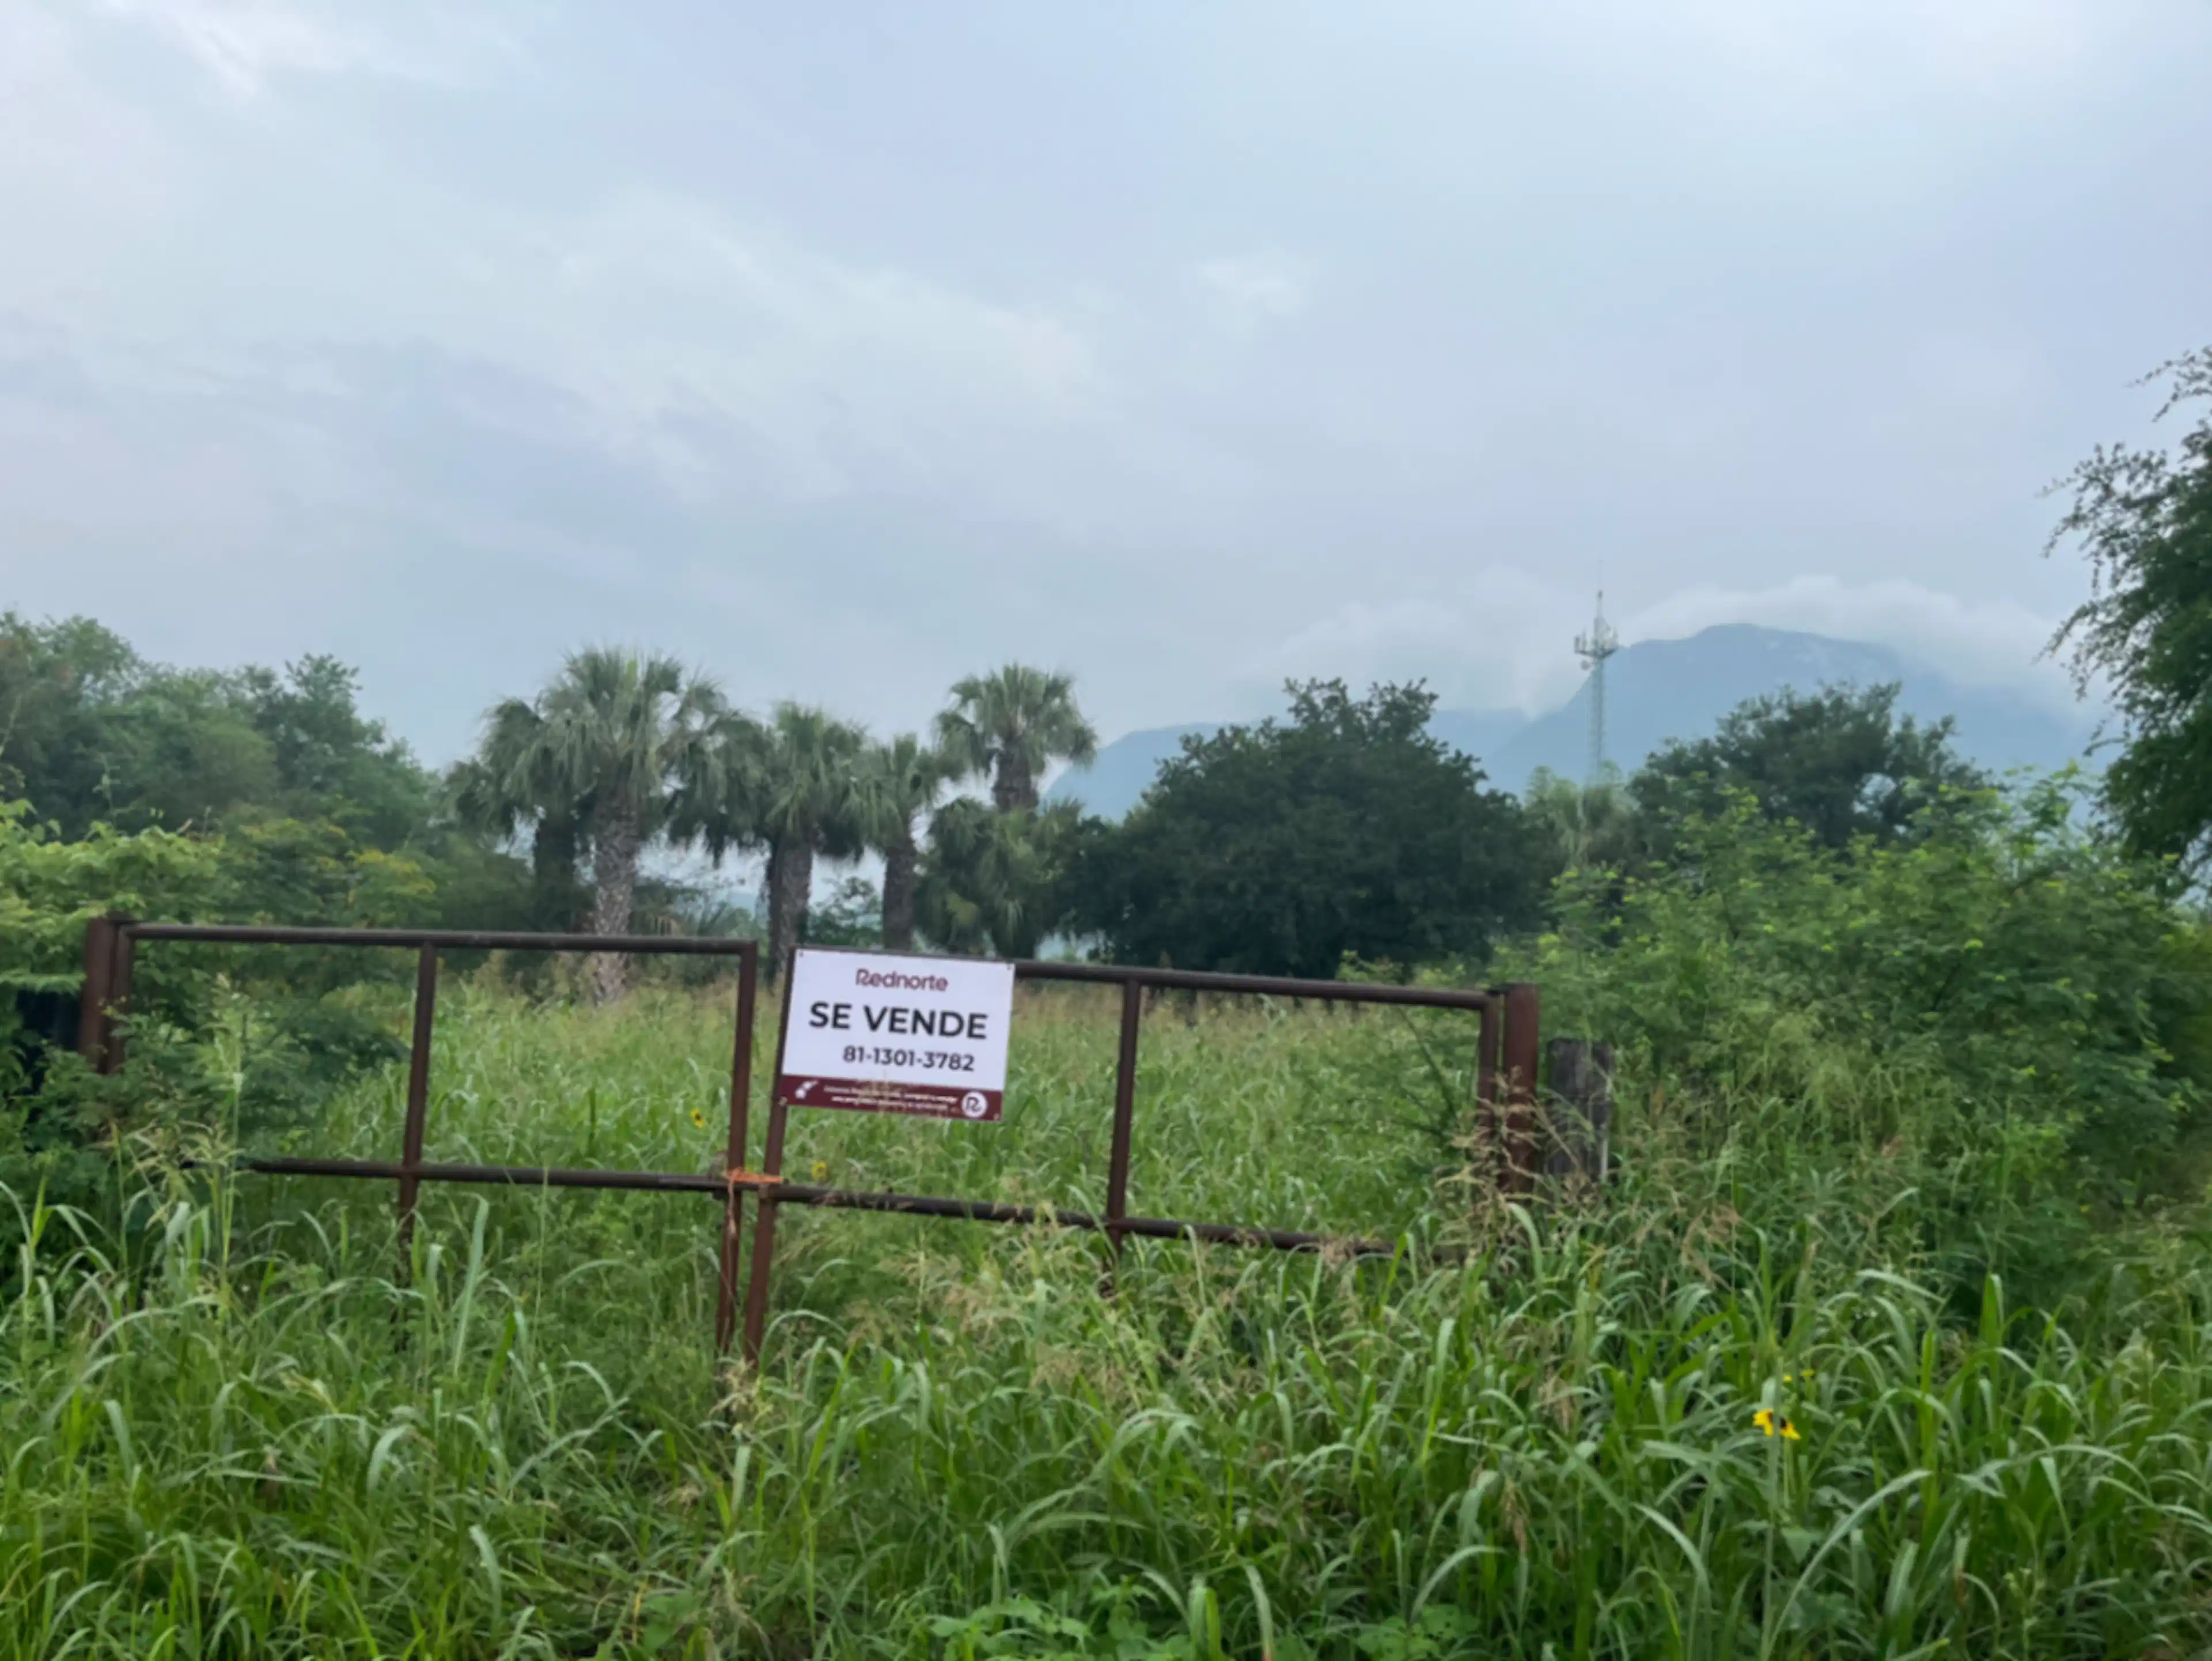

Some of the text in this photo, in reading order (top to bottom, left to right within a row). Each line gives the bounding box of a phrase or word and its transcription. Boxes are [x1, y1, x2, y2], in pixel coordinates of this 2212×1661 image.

[855, 968, 948, 992] Rednorte
[809, 1001, 988, 1039] SE VENDE
[843, 1045, 975, 1072] 81-1301-3782
